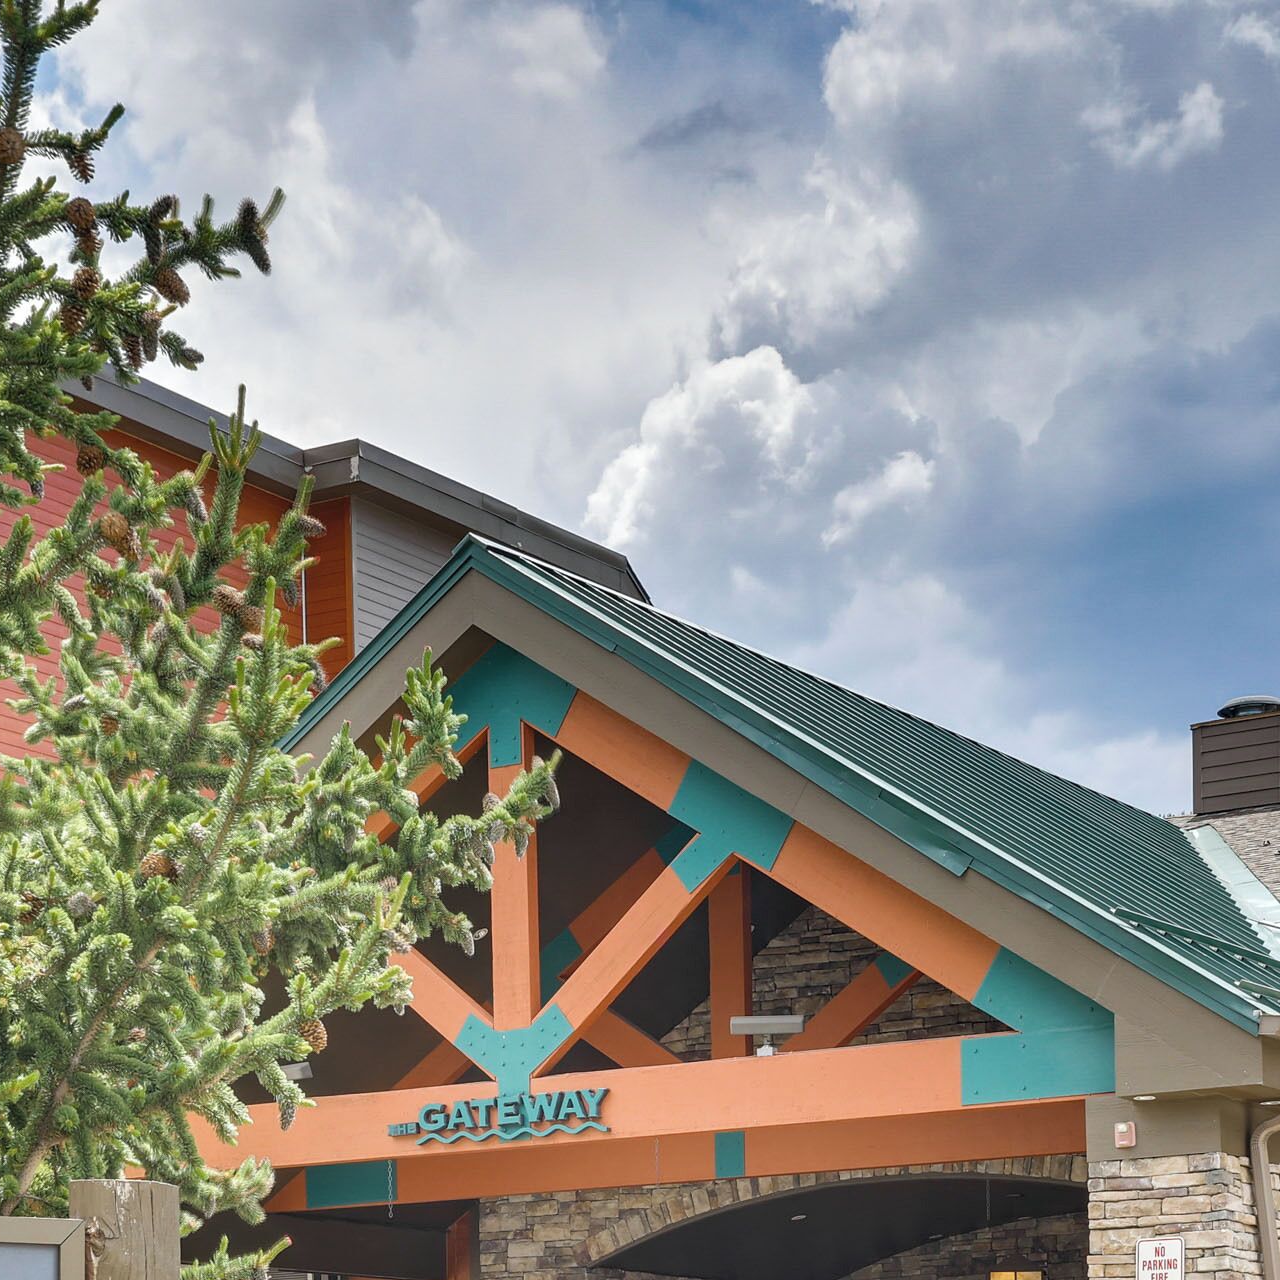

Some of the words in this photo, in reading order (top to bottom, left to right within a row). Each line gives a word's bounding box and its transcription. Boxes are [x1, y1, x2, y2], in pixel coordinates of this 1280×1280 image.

[419, 1088, 610, 1132] GATEWAY
[1154, 1246, 1165, 1257] NO
[1142, 1258, 1178, 1271] PARKING
